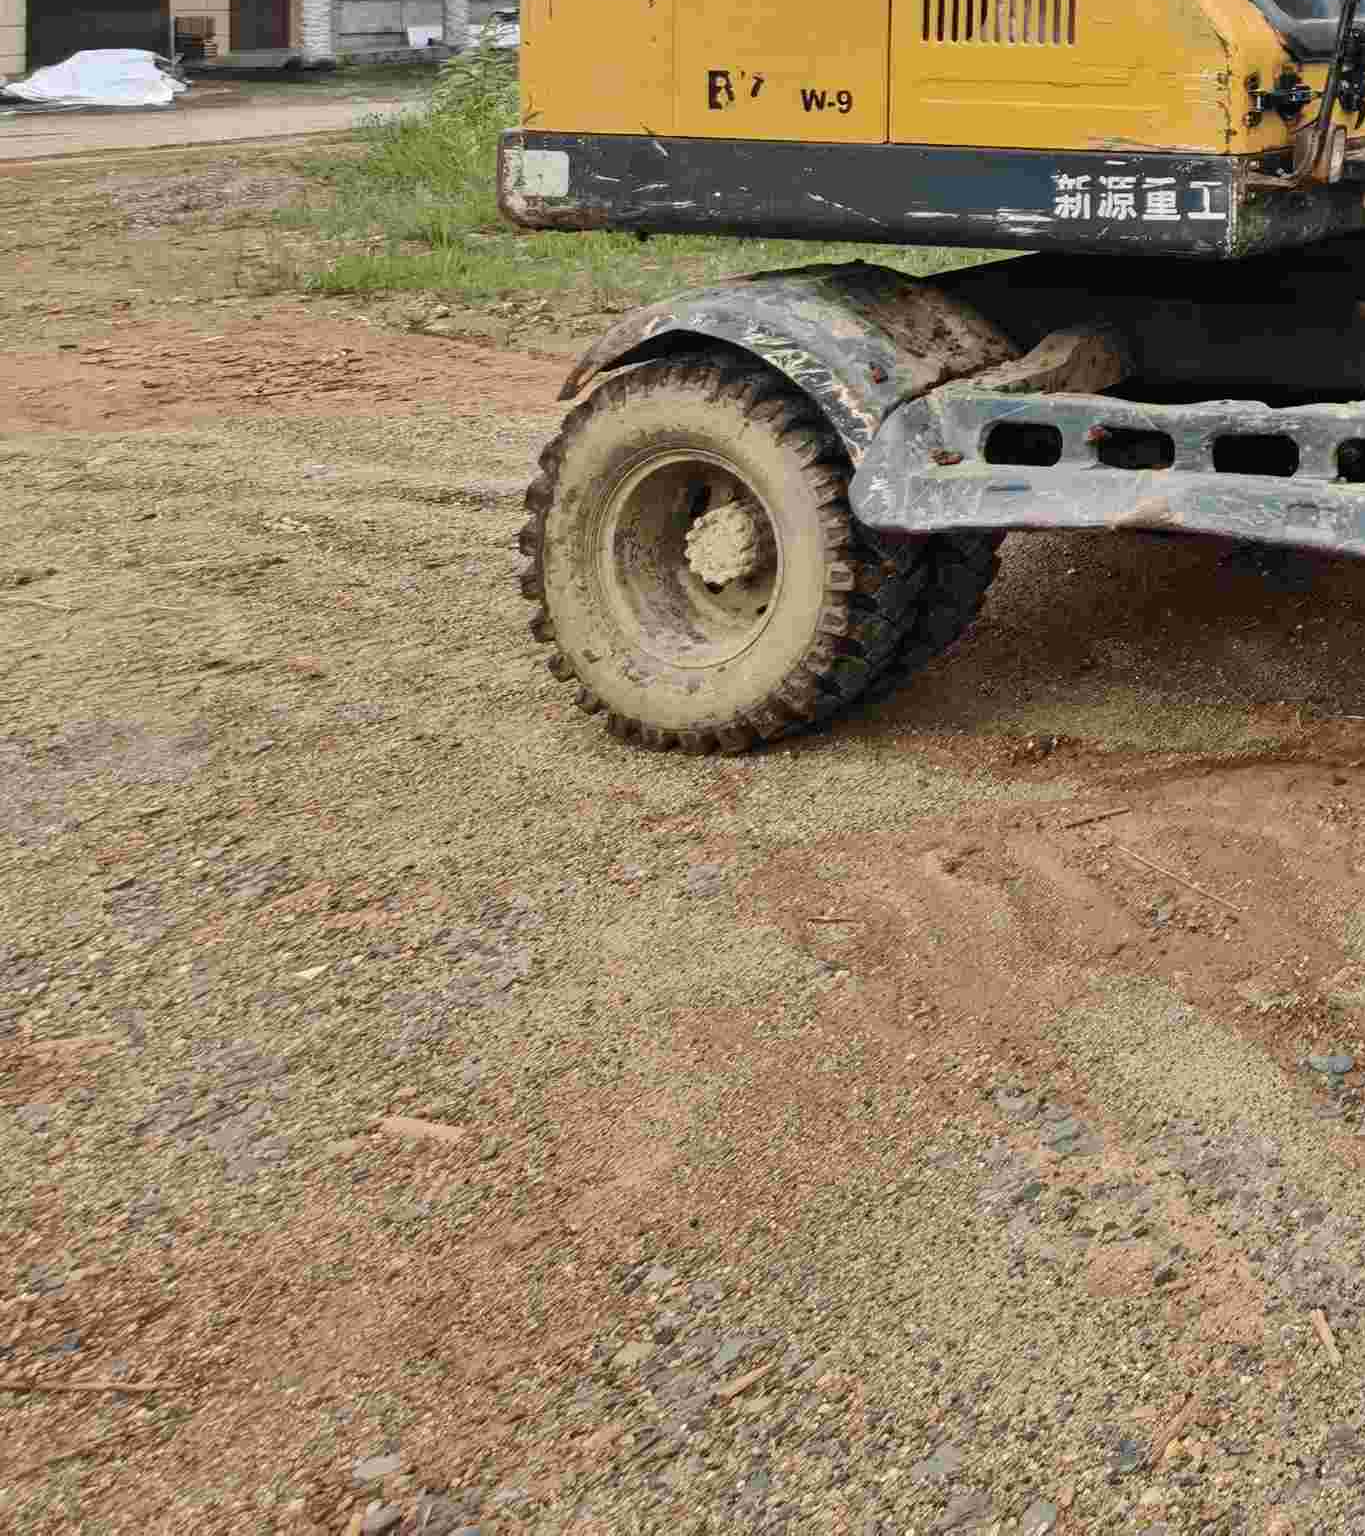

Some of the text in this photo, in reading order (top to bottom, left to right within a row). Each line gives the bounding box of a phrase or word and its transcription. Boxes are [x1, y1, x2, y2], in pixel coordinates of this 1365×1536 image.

[800, 88, 853, 114] W-9
[1052, 173, 1227, 221] 新源重工
